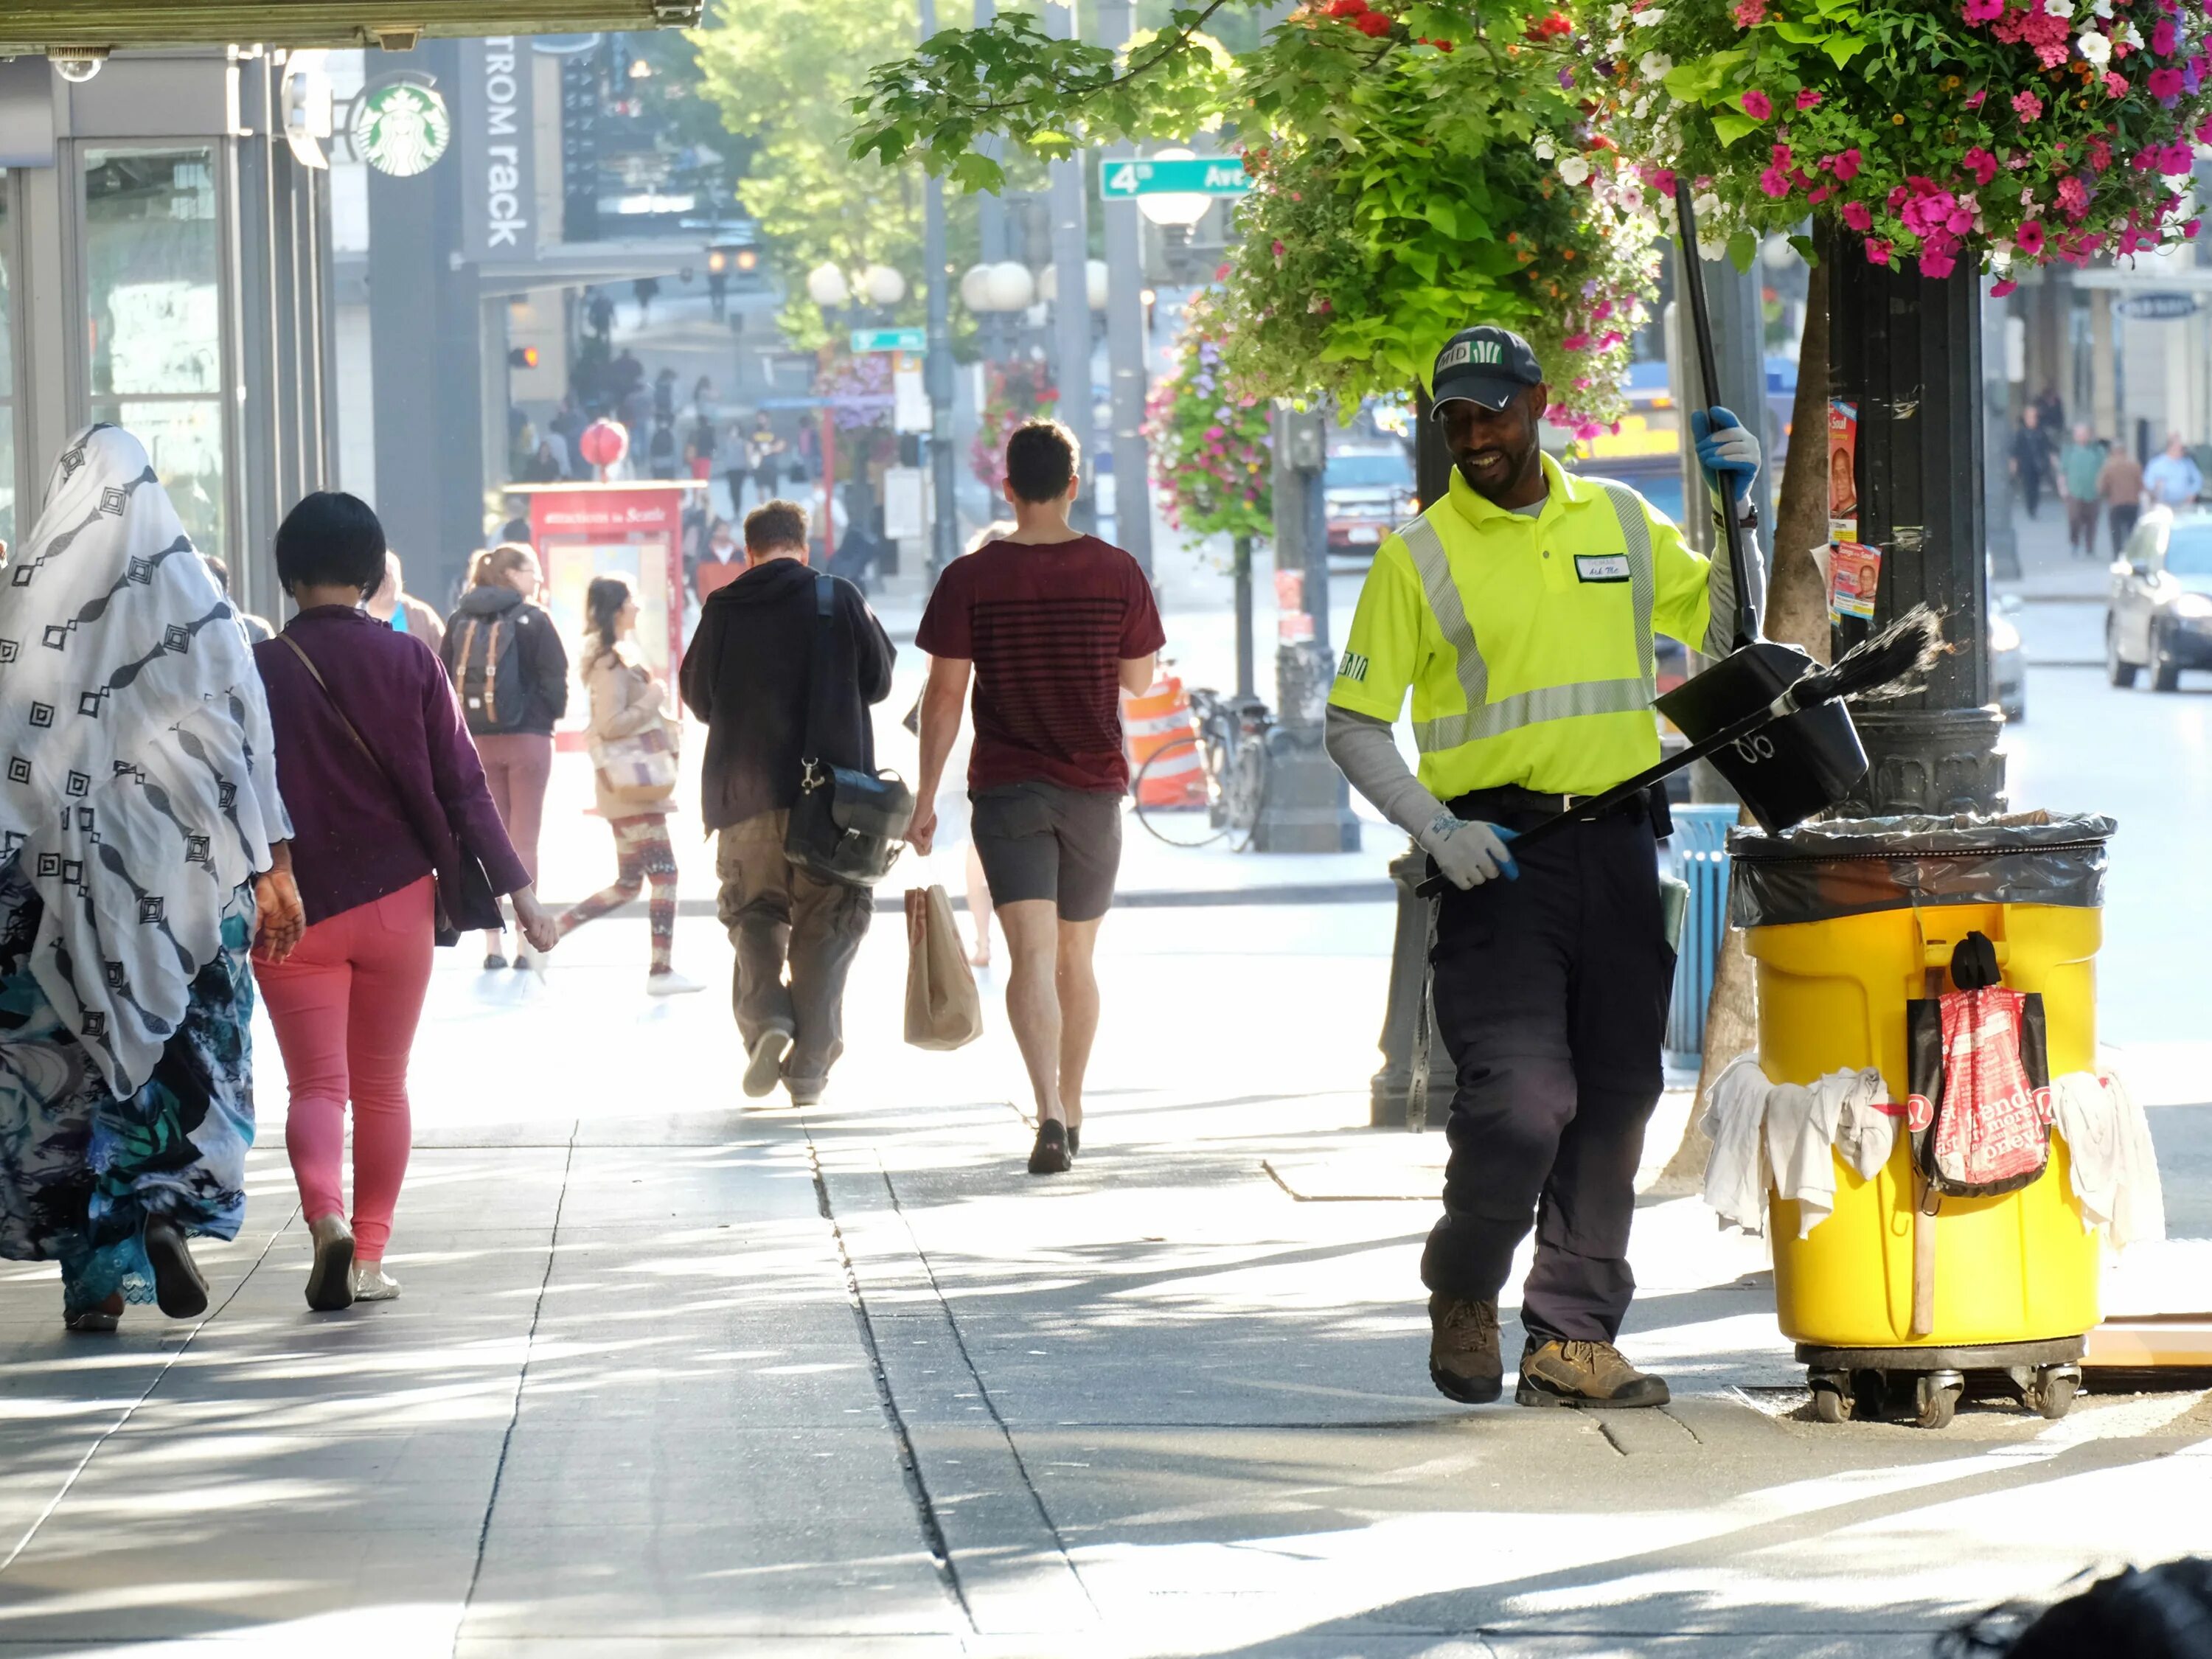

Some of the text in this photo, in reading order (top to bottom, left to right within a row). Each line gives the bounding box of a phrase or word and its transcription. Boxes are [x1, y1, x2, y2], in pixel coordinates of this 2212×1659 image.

[487, 145, 527, 248] rack
[1439, 347, 1467, 368] MID
[1986, 1105, 2033, 1130] more
